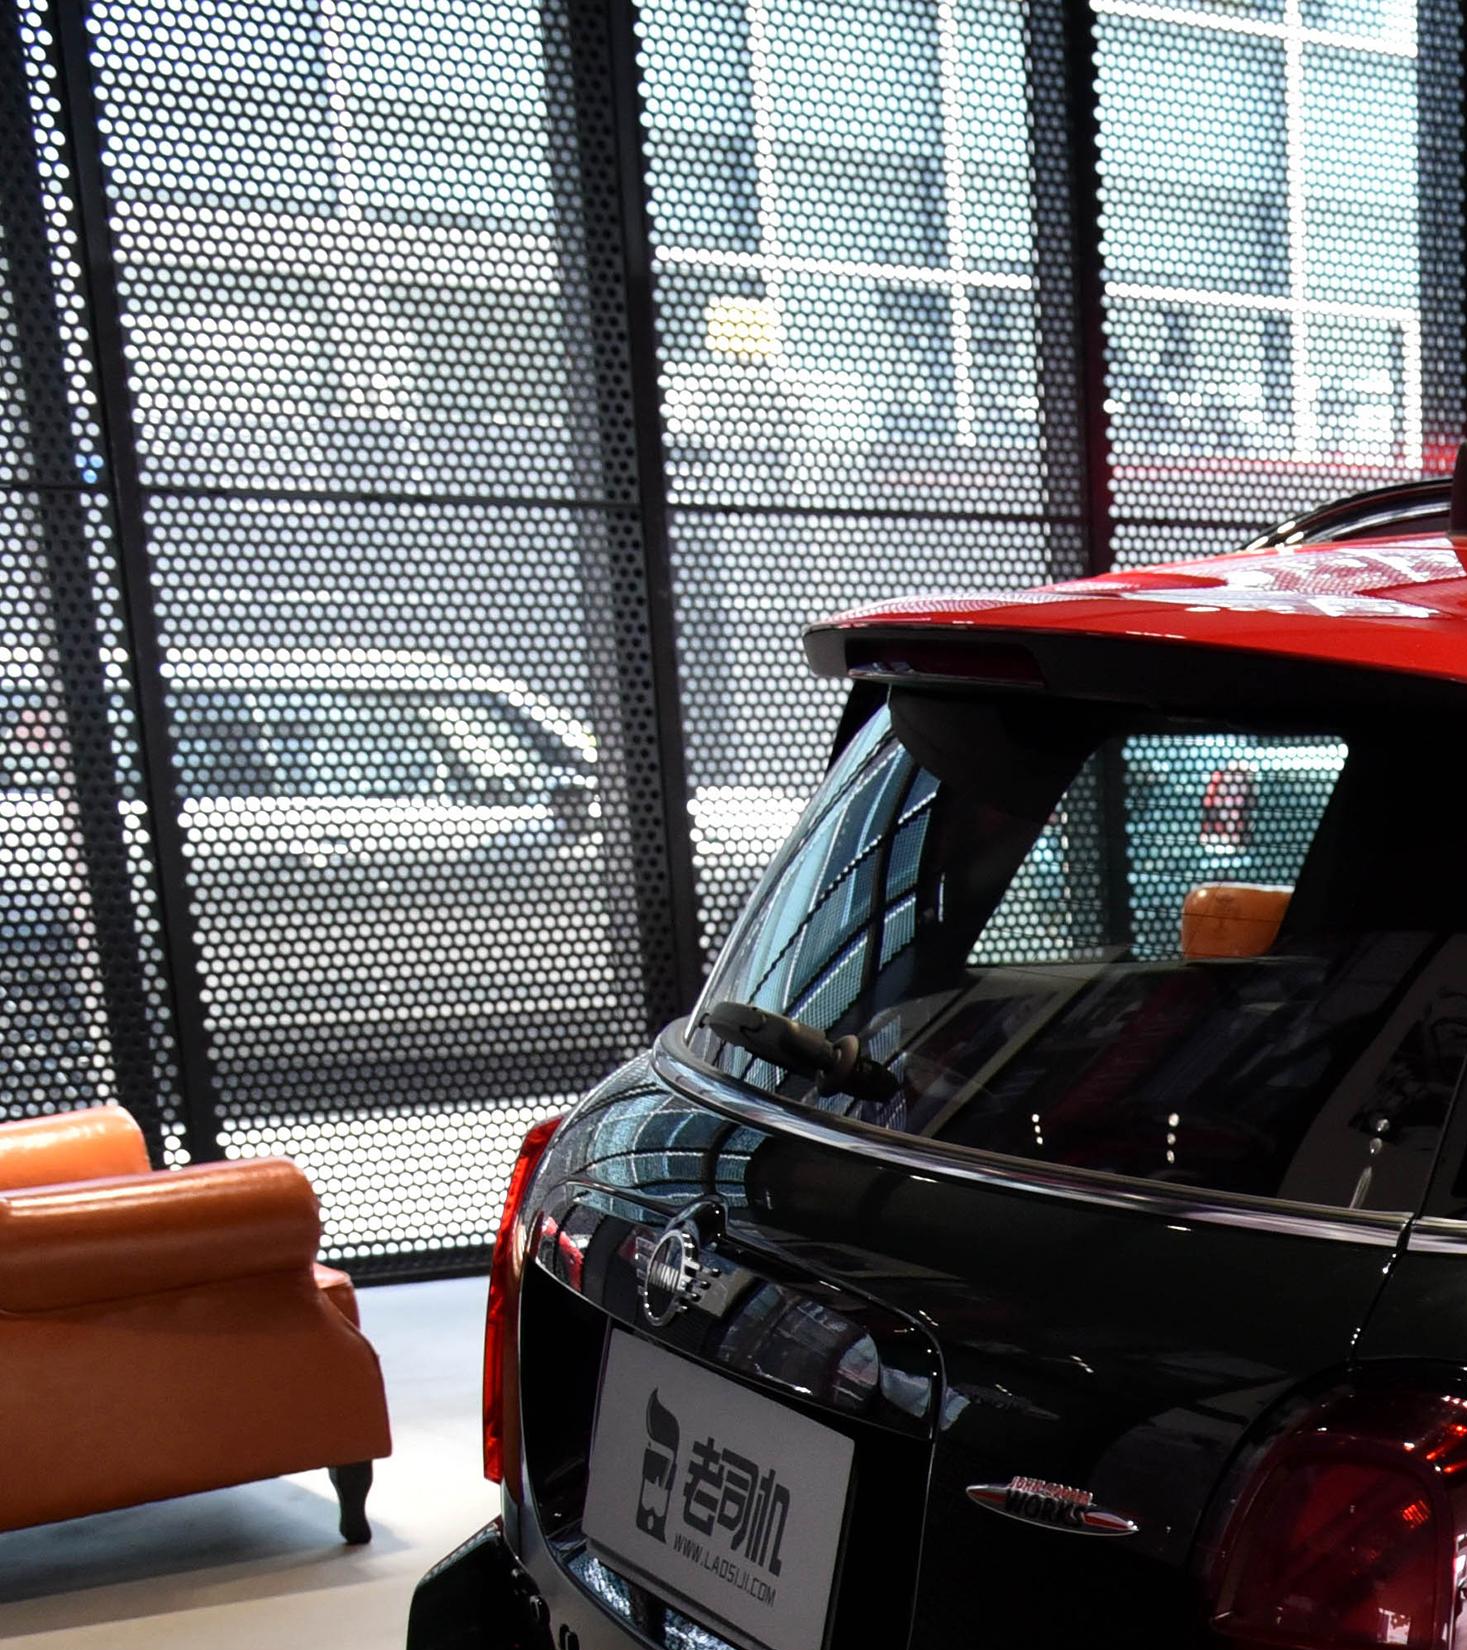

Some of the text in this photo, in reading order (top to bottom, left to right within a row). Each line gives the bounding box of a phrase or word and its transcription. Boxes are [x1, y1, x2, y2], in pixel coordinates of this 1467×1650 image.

[683, 1436, 791, 1578] 老司机
[673, 1533, 777, 1608] WWW.LAOSIJI.COM
